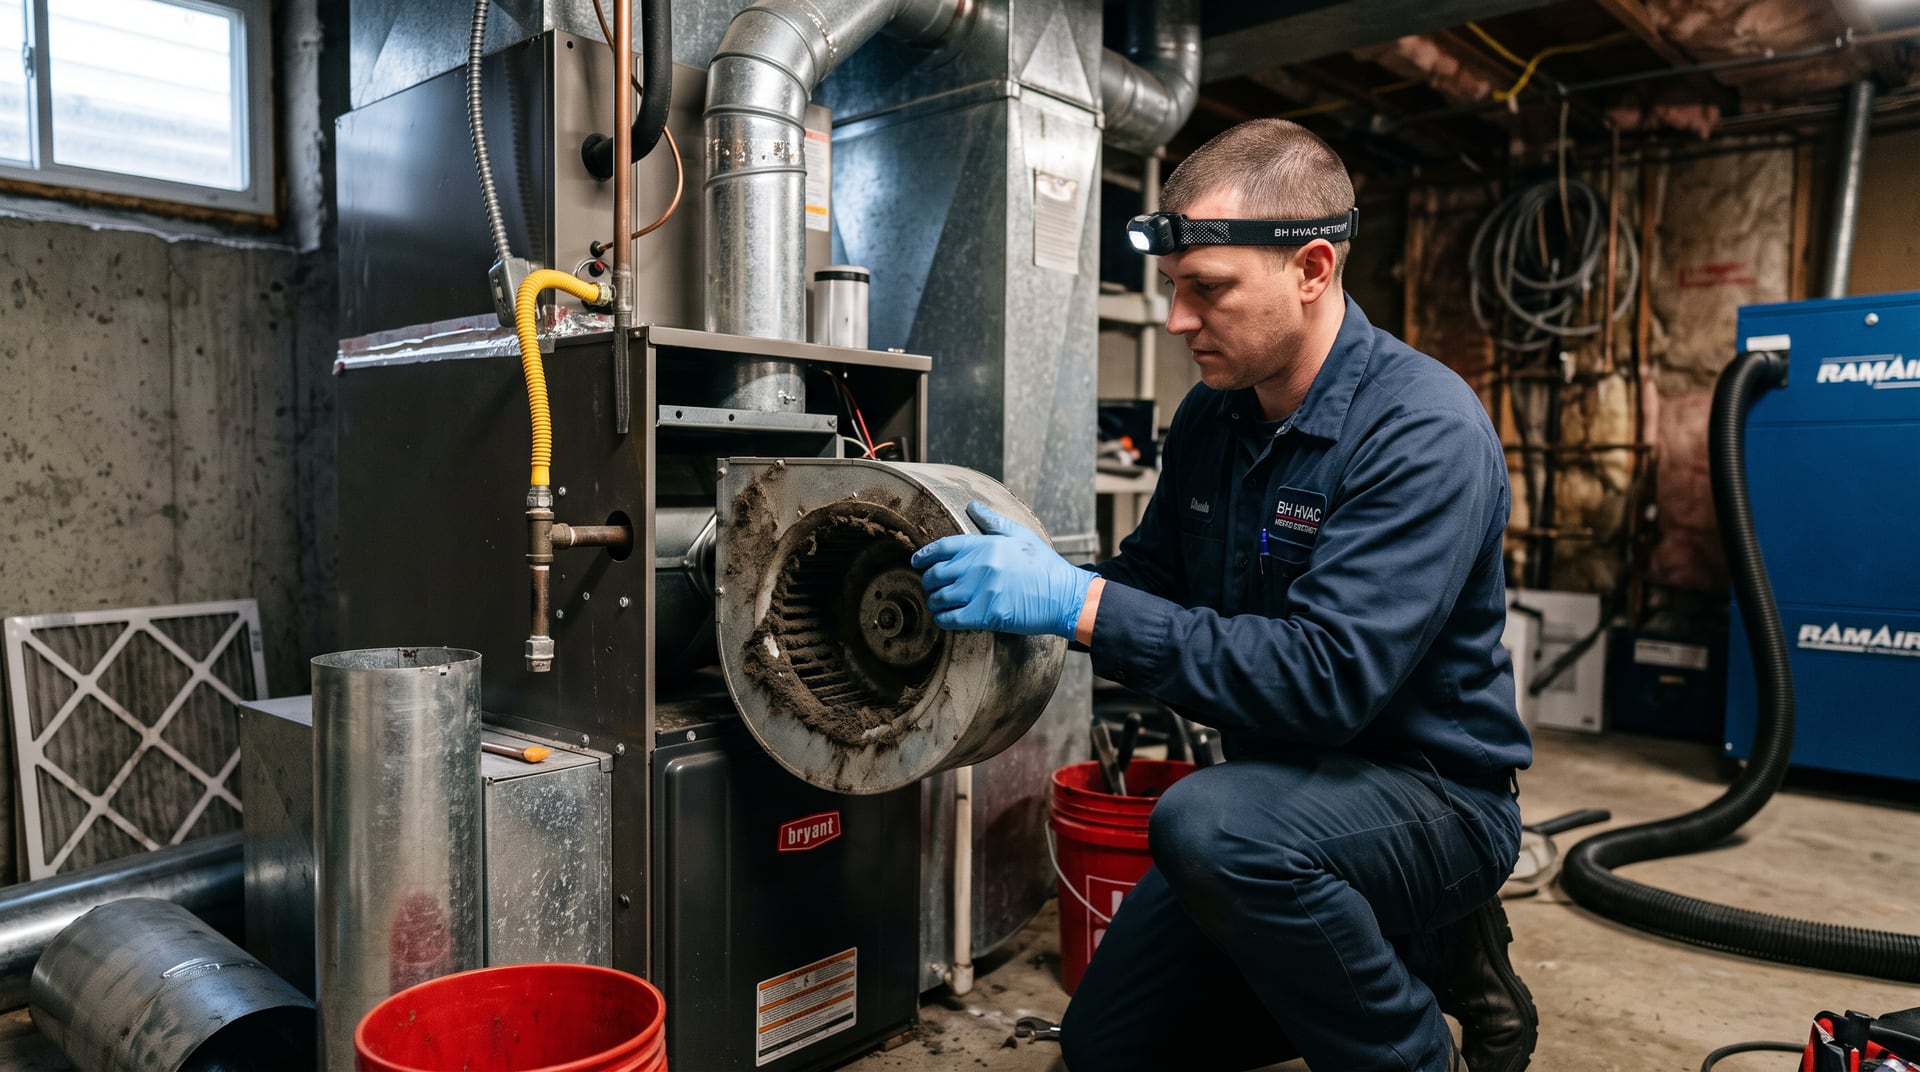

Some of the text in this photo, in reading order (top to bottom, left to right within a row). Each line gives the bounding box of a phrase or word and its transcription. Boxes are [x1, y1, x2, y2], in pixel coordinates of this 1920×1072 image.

[1274, 228, 1289, 237] BH
[1292, 227, 1318, 237] HVAC
[1816, 354, 1920, 386] RAMAI
[1277, 500, 1321, 522] BH HVAC
[1798, 622, 1920, 650] RAMAIR
[788, 817, 834, 845] bryant
